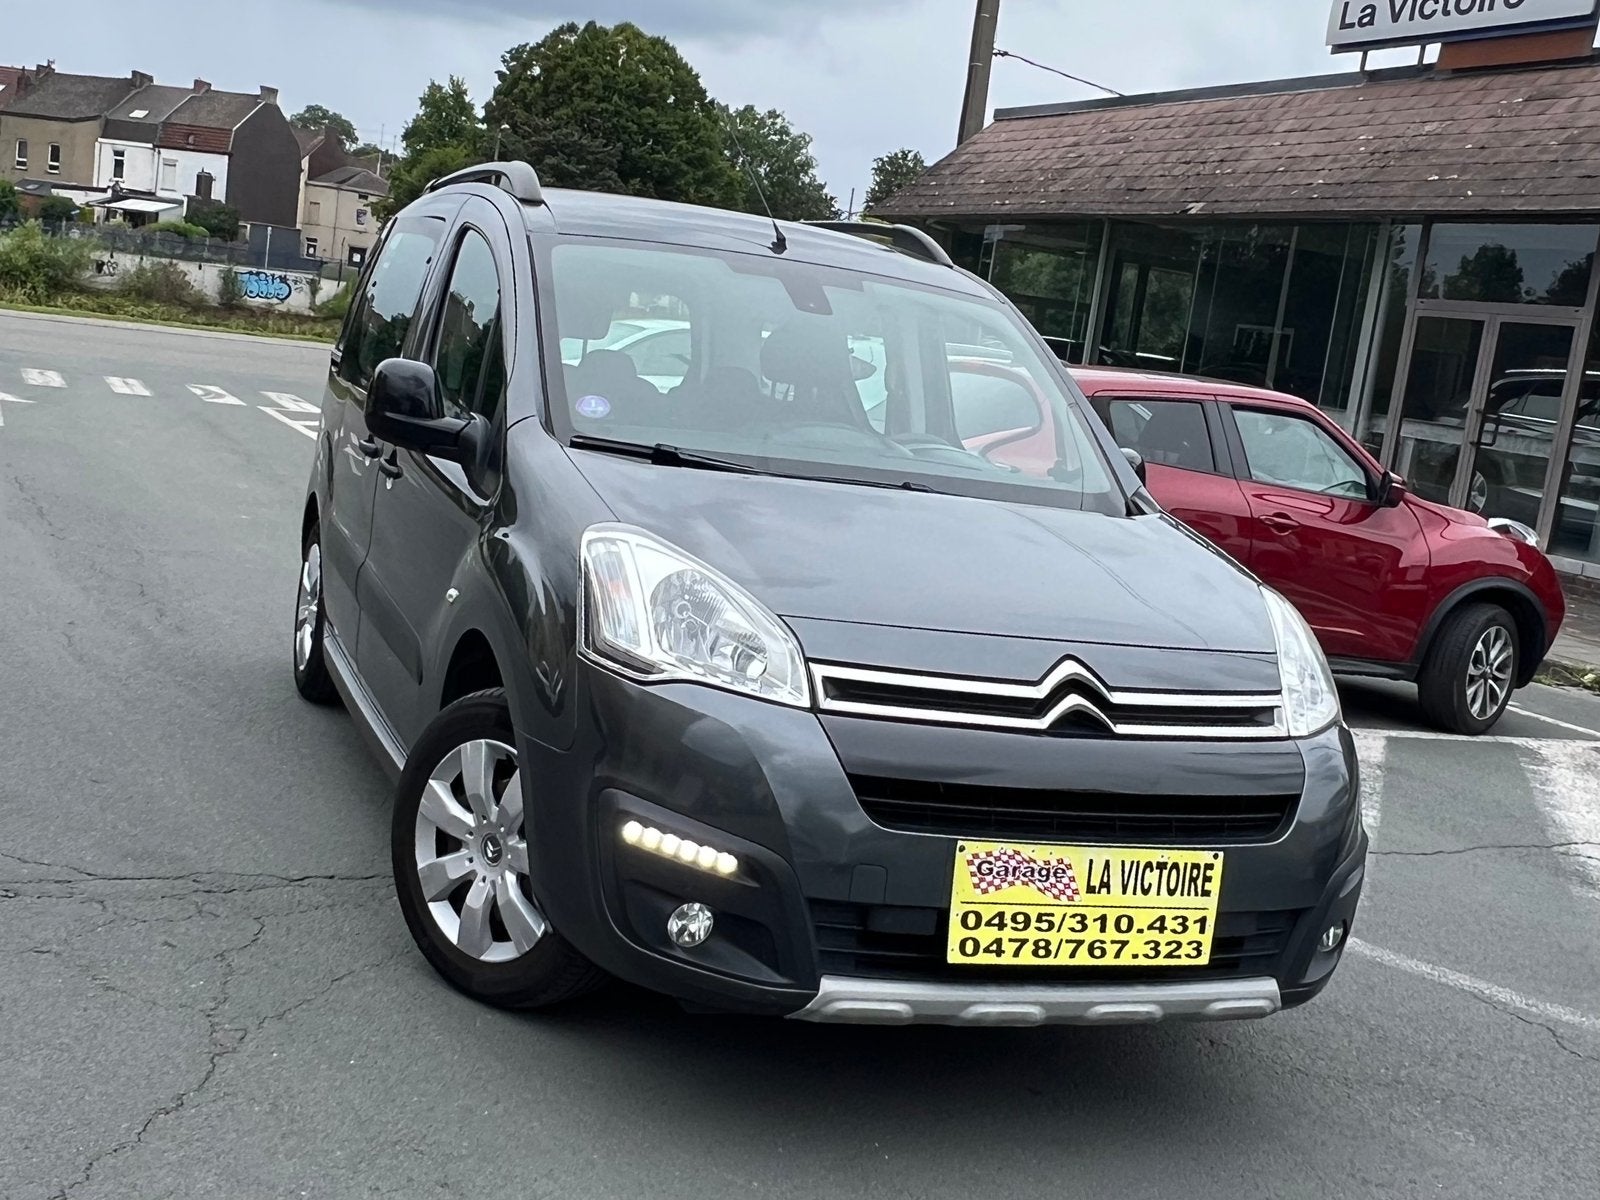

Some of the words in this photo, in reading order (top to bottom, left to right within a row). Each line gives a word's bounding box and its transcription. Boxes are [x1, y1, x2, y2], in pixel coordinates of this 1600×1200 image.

[1339, 1, 1377, 30] La
[976, 860, 1067, 883] Garage
[1085, 858, 1111, 895] LA
[1121, 860, 1214, 897] VICTOIRE
[960, 910, 1208, 935] 0495/310.431
[958, 937, 1203, 959] 0478/767.323
